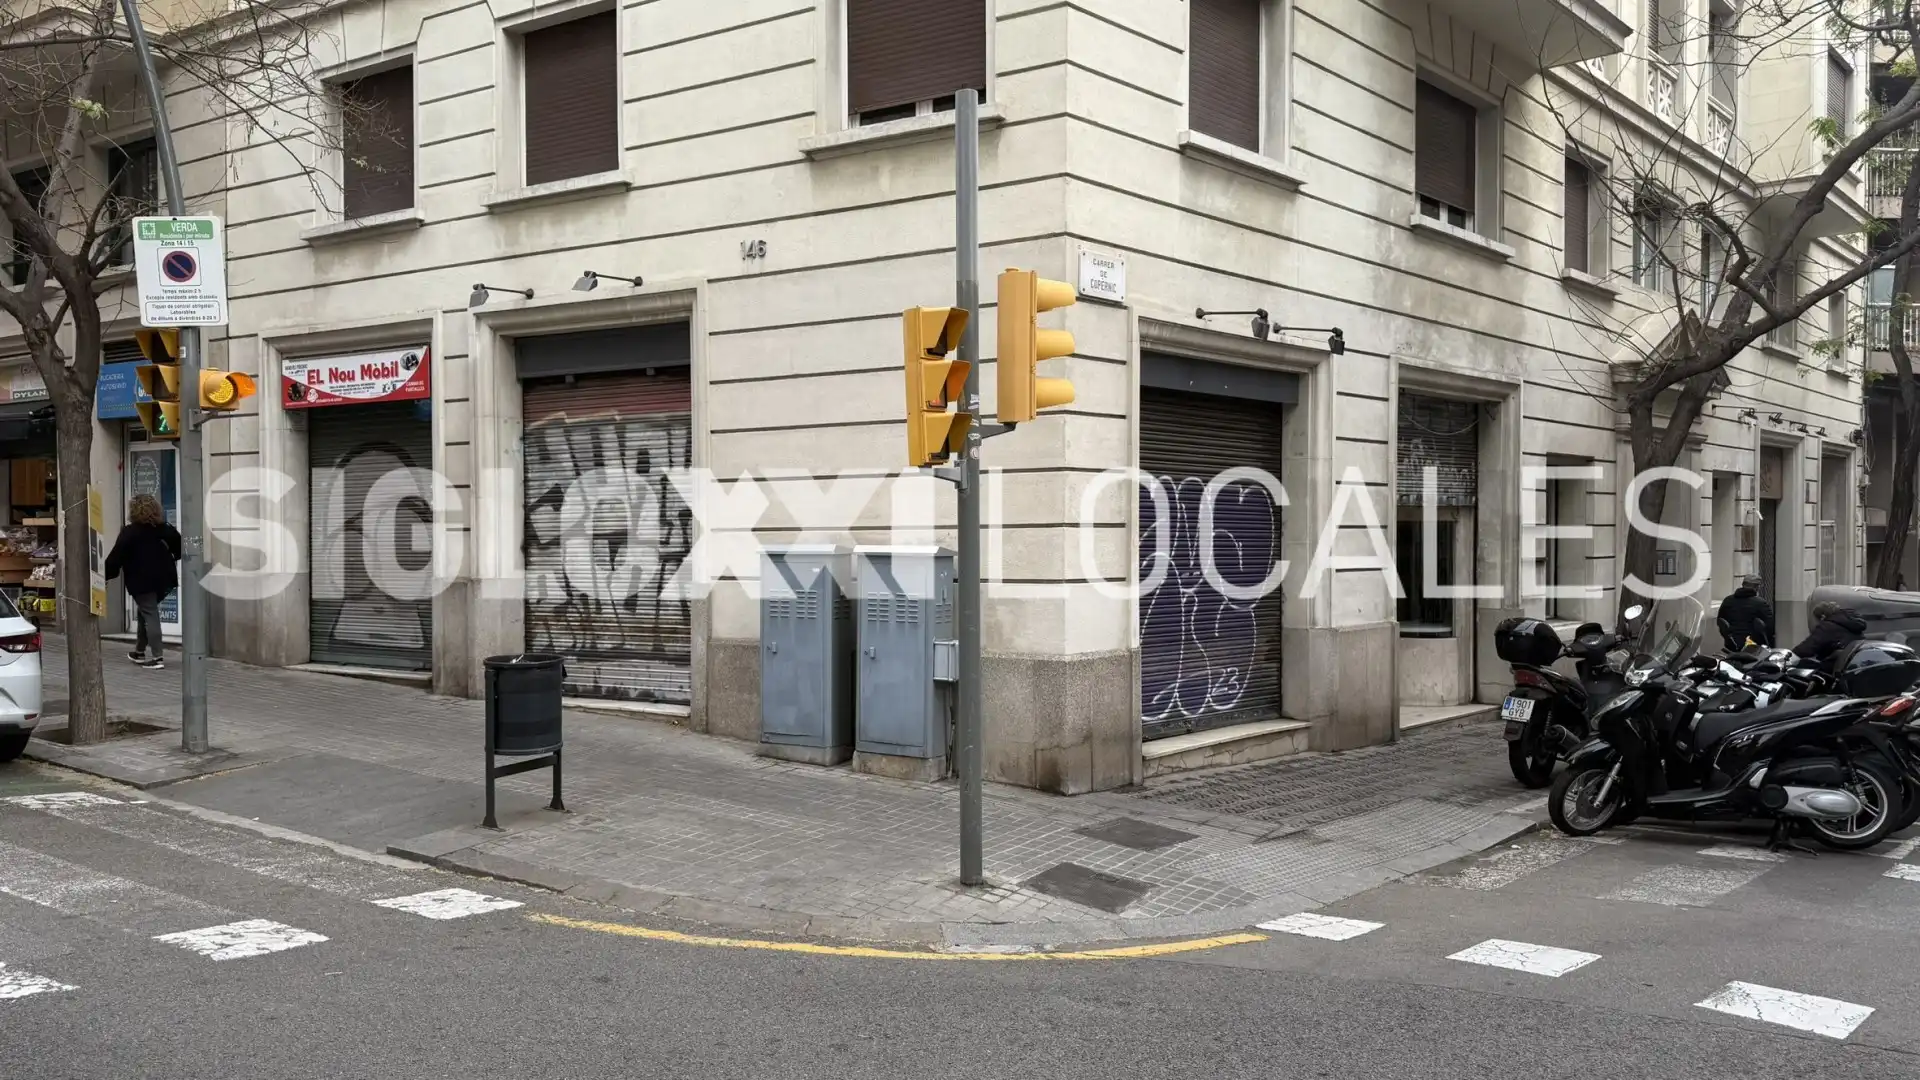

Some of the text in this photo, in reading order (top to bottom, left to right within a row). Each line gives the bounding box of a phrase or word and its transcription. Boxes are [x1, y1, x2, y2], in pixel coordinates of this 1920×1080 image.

[170, 222, 198, 232] VERDA
[740, 240, 767, 260] 146
[1092, 258, 1115, 269] CARRER
[1099, 270, 1108, 279] DE
[307, 368, 324, 386] EL
[328, 366, 356, 384] Nou
[360, 360, 399, 381] Mòbil
[14, 390, 46, 399] DYLAN
[1512, 698, 1532, 709] 1901
